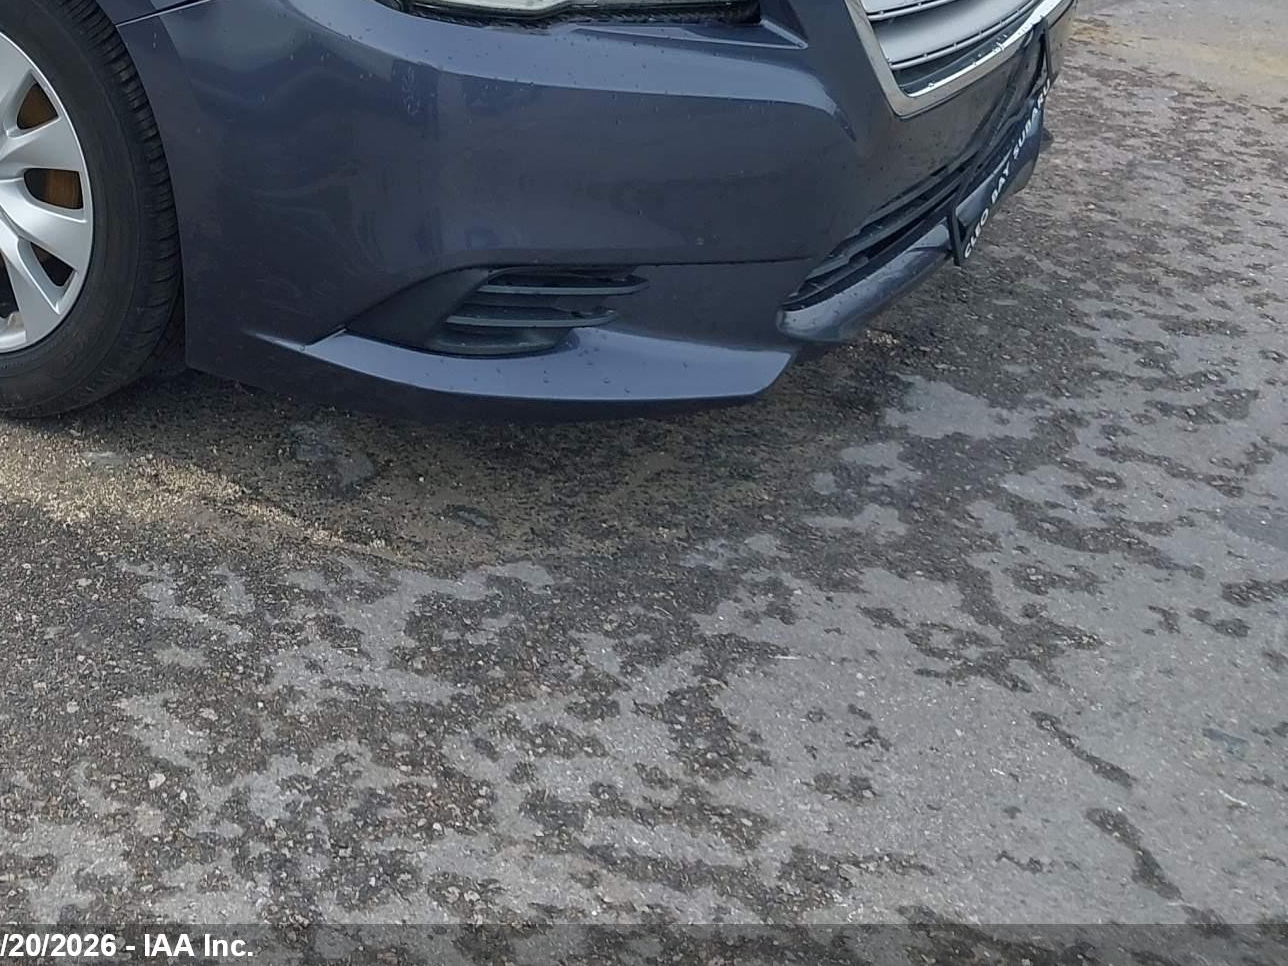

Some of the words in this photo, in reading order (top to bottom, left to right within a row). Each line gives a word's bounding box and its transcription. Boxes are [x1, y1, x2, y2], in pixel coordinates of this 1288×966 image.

[964, 208, 989, 258] CLEO
[991, 161, 1010, 204] BAY
[1013, 78, 1051, 160] SUBARU
